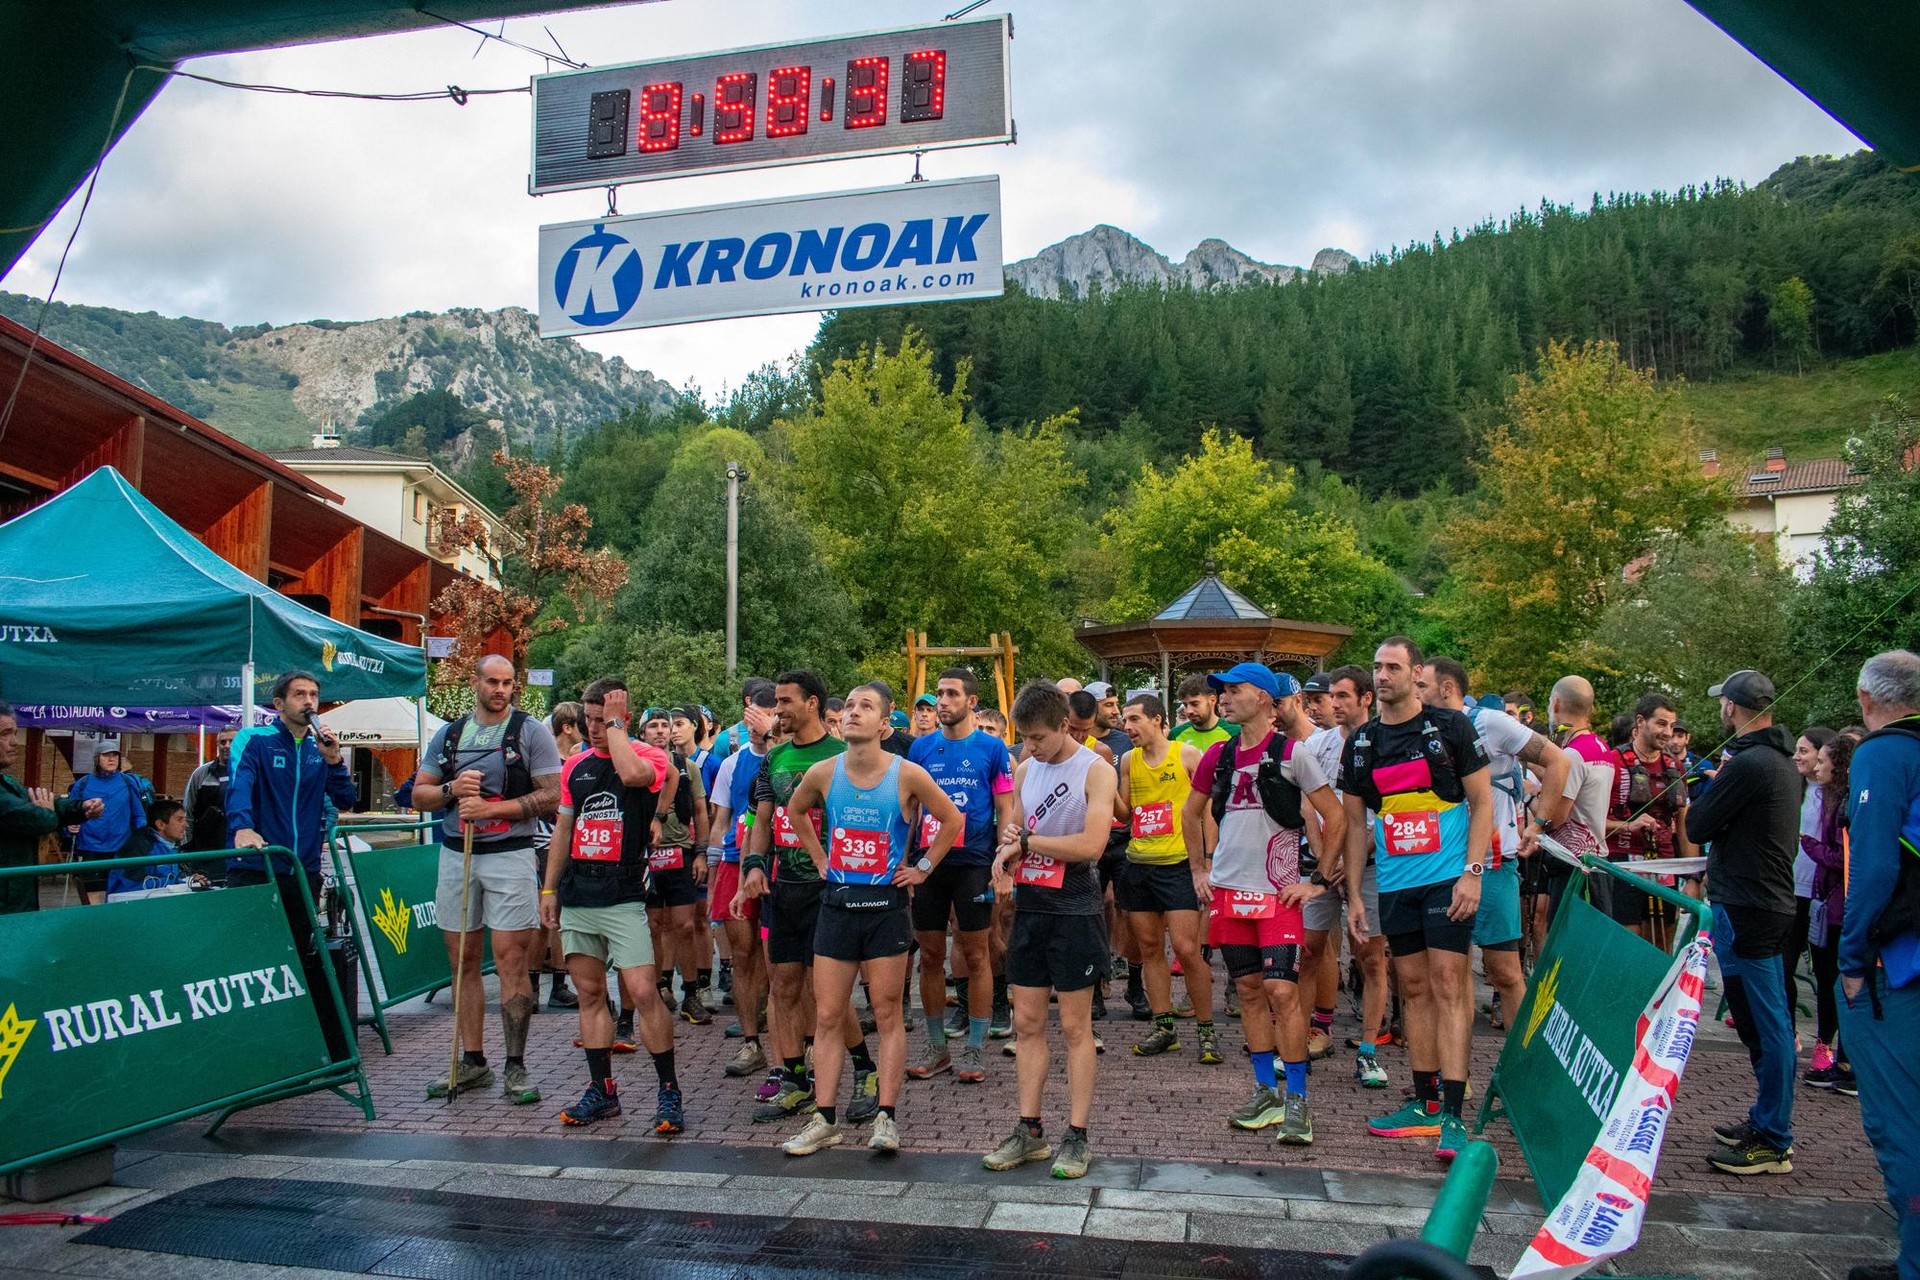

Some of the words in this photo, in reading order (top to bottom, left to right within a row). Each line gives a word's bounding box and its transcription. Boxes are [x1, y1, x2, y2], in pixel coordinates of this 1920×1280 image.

[638, 51, 945, 153] 8:58:37
[652, 213, 989, 290] KRONOAK
[800, 270, 976, 299] kronoak.com
[33, 705, 46, 719] LA
[1140, 809, 1164, 823] 257
[580, 828, 611, 843] 318
[1392, 820, 1427, 836] 284
[841, 837, 876, 855] 336
[845, 900, 889, 908] SALOMON
[44, 988, 181, 1052] RURAL
[183, 963, 305, 1021] KUTXA
[1543, 1000, 1580, 1070] RURAL
[1568, 1033, 1620, 1124] KUTXA
